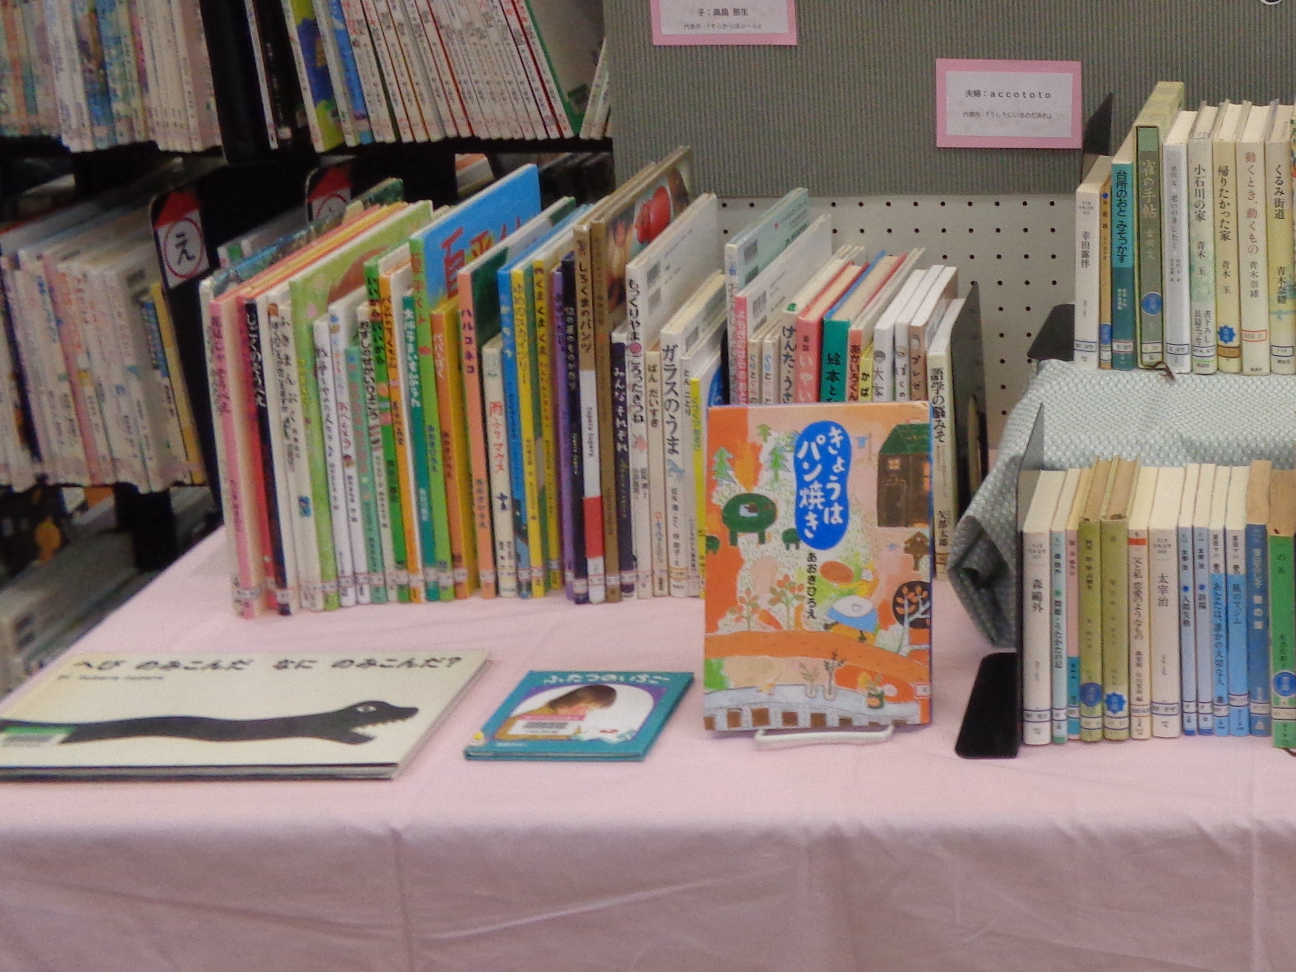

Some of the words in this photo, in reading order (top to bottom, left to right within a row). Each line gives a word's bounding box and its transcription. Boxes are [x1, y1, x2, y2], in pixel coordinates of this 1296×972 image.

[1193, 164, 1206, 222] 小石川の家
[1218, 165, 1231, 242] 帰りたかった家
[1273, 164, 1286, 220] くるみ街道
[797, 435, 826, 539] パン焼き
[823, 426, 846, 526] きょうは
[806, 551, 818, 620] あおきひろえ
